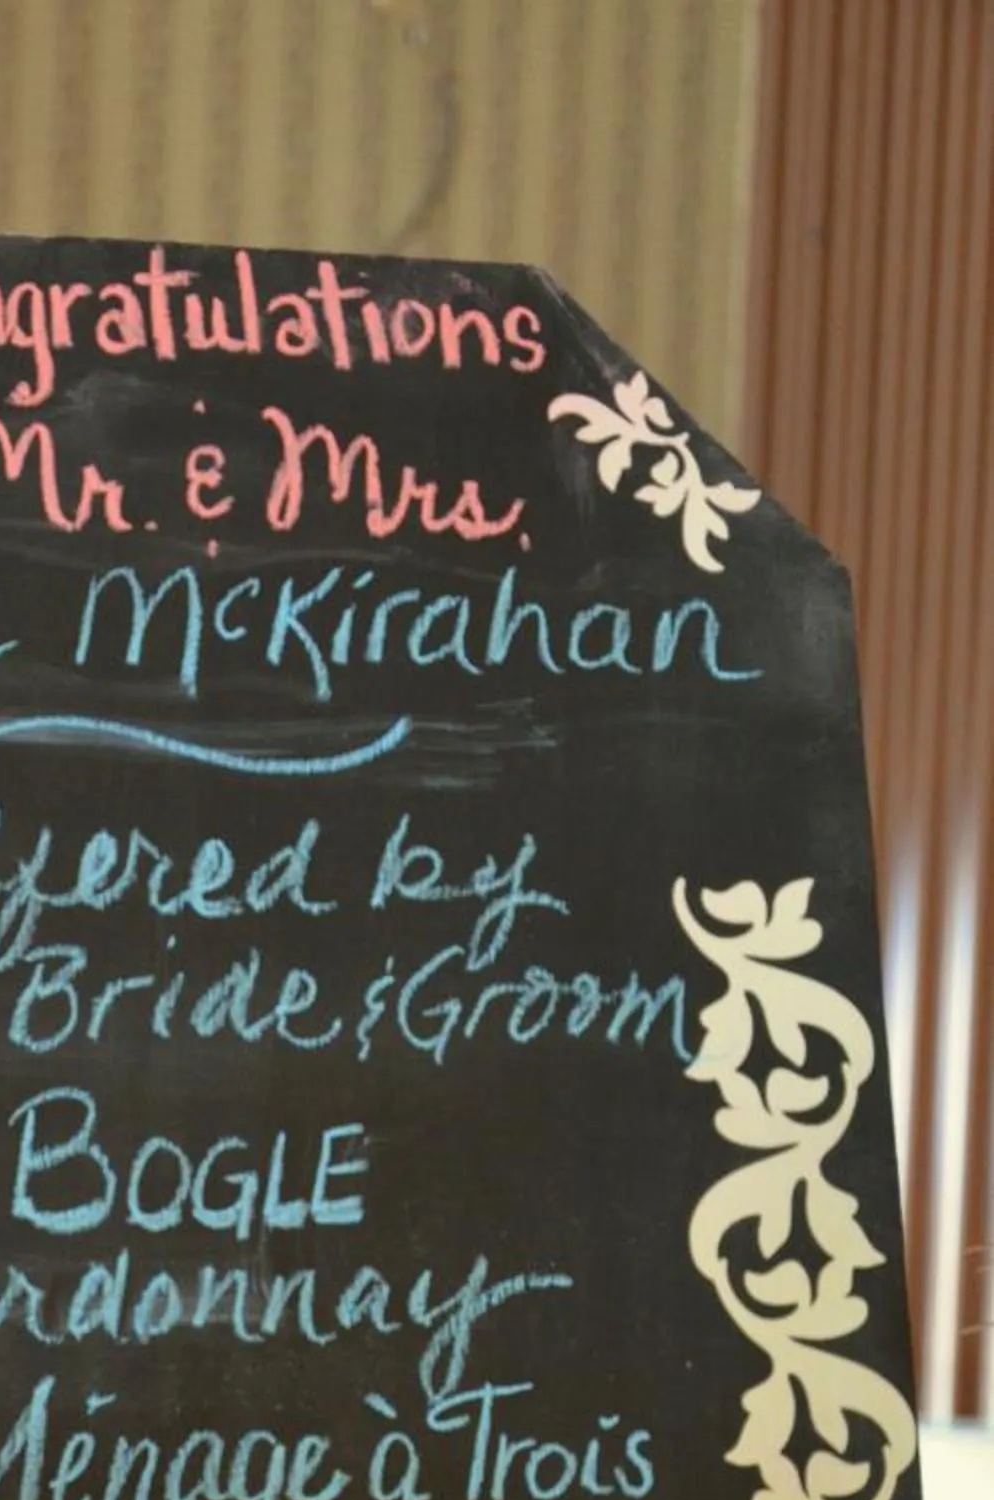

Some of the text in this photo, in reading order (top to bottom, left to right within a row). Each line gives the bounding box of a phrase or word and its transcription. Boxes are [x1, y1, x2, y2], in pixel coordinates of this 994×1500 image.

[264, 408, 531, 552] Mrs.
[74, 564, 762, 702] McKirahan
[368, 812, 570, 970] by
[6, 935, 344, 1054] Bride
[399, 947, 712, 1066] Groom
[8, 1084, 372, 1242] BOGLE
